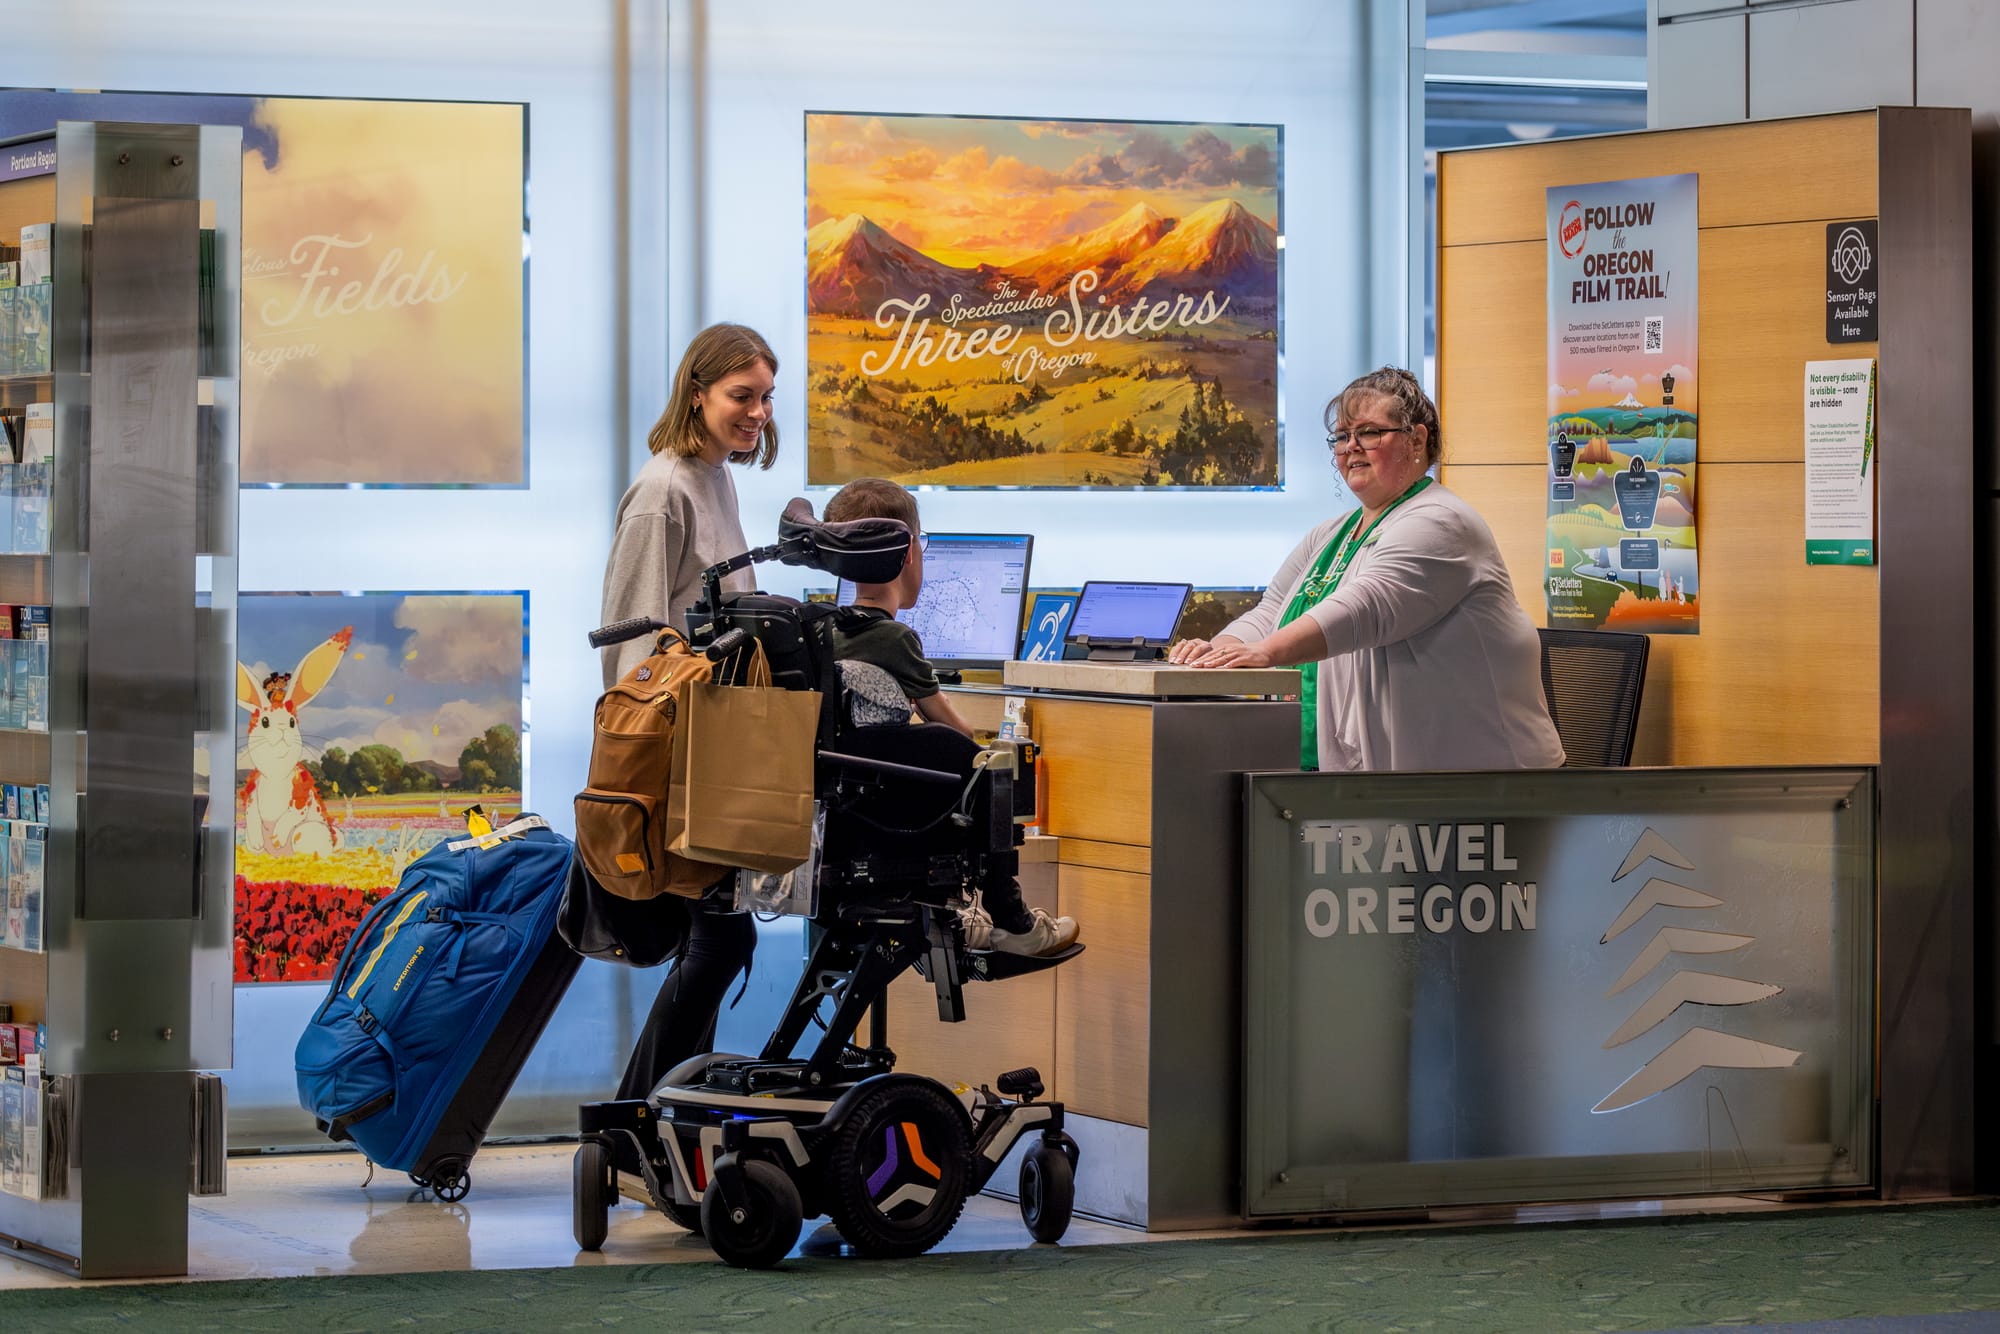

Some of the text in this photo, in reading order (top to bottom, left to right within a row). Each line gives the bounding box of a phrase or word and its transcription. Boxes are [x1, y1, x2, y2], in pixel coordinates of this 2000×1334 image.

[11, 153, 37, 171] Portland
[1585, 202, 1655, 231] FOLLOW
[1613, 229, 1626, 249] the
[242, 255, 289, 273] elous
[1583, 249, 1654, 277] OREGON
[260, 232, 468, 327] Fields
[1572, 271, 1670, 304] FILM TRAIL!
[993, 281, 1019, 301] The
[1827, 287, 1877, 305] Sensory Bags
[941, 289, 1058, 327] Spectacular
[1834, 305, 1869, 320] Available
[860, 269, 1231, 377] Three Sisters
[1568, 320, 1641, 332] Download the SetJetters app to
[1842, 323, 1861, 337] Here
[1563, 335, 1581, 343] discover
[1596, 333, 1617, 342] locations
[1617, 332, 1629, 340] from
[242, 341, 320, 375] regon
[1569, 343, 1636, 354] 500 movies filmed in Oregon
[1001, 345, 1098, 384] of Oregon
[1810, 372, 1867, 384] Not every disability
[1810, 387, 1816, 395] is
[1816, 386, 1836, 395] visible
[1843, 386, 1858, 394] some
[1810, 398, 1843, 408] are hidden
[1301, 822, 1518, 875] TRAVEL
[1303, 881, 1537, 938] OREGON
[393, 945, 425, 991] EXPEDITION 30
